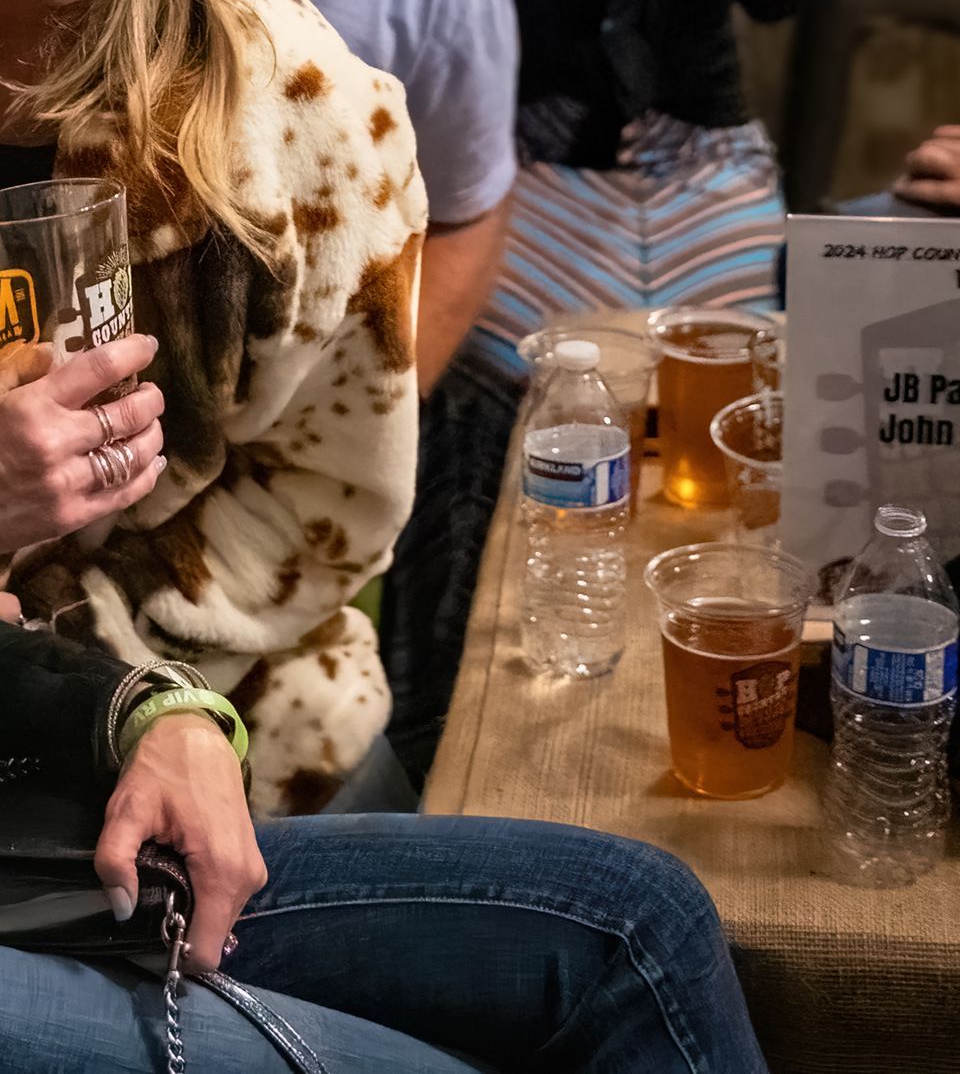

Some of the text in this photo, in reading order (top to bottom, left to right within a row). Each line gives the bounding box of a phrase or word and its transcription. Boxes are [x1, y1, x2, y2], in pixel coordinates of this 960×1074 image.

[823, 243, 866, 259] 2024
[872, 245, 908, 261] HOP
[884, 372, 960, 405] JB Pa
[878, 414, 953, 445] John
